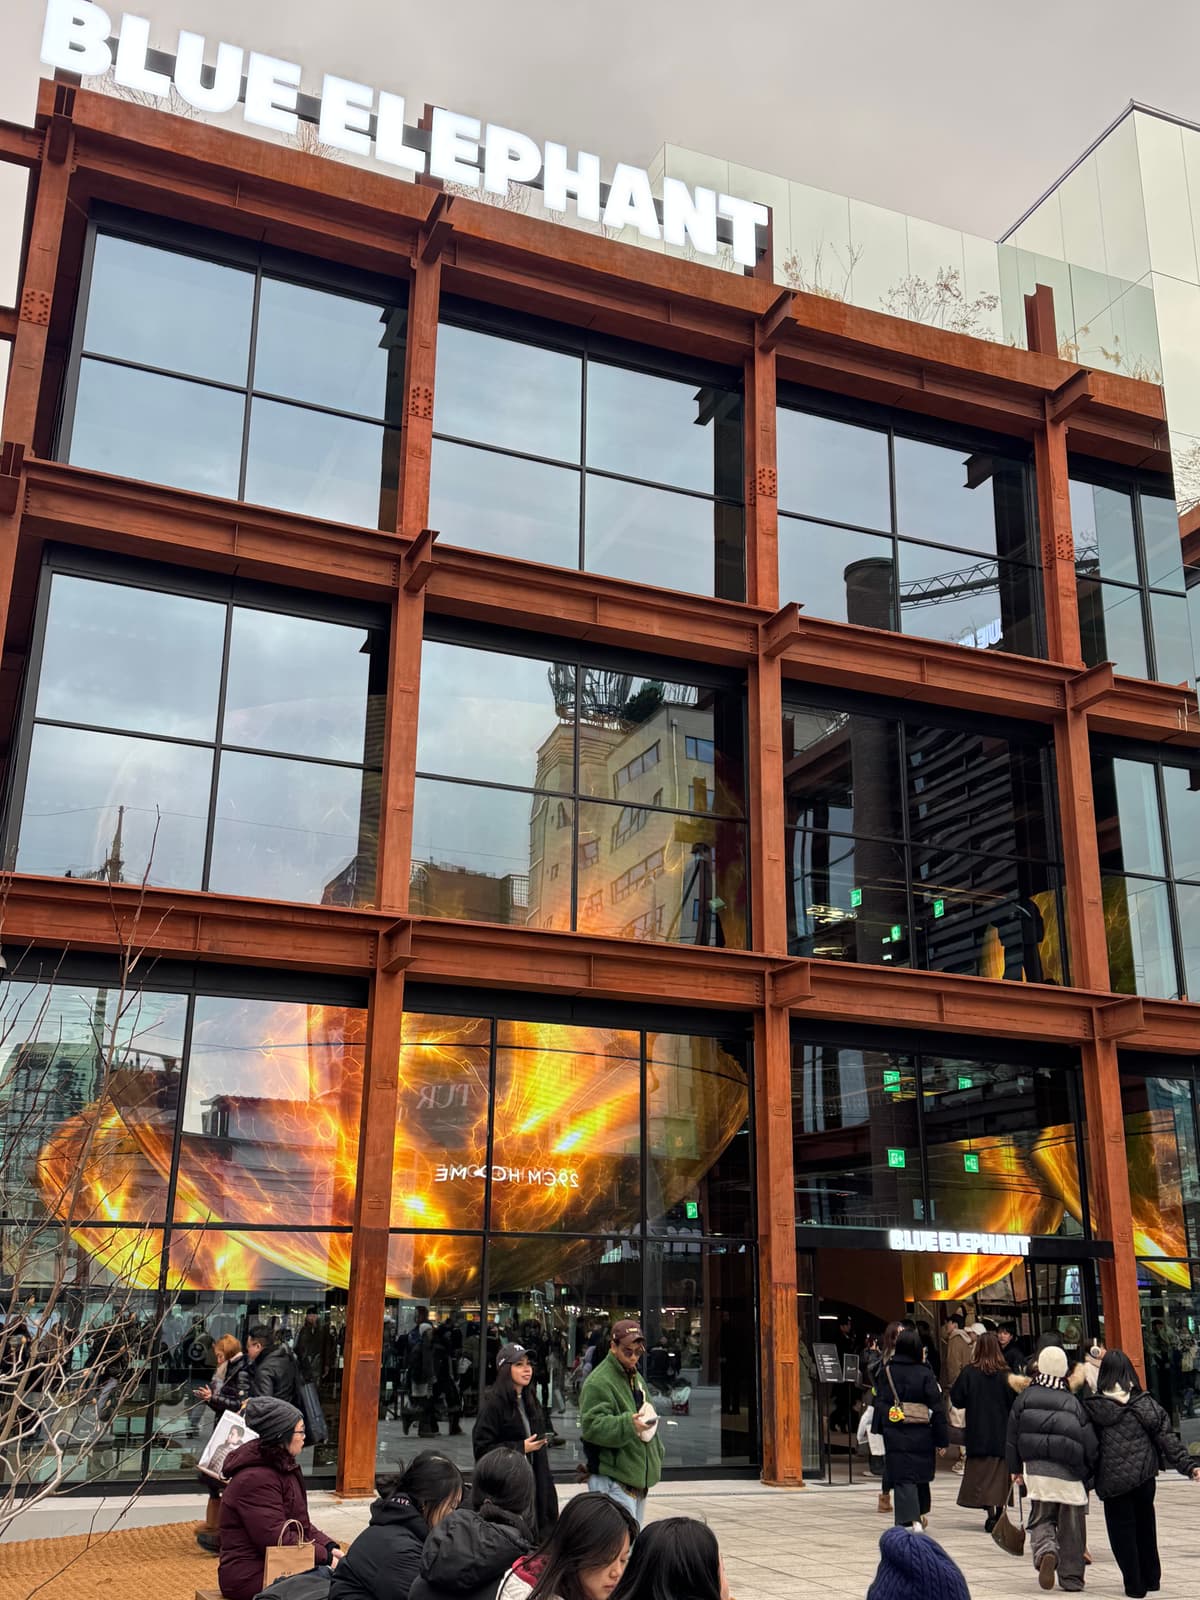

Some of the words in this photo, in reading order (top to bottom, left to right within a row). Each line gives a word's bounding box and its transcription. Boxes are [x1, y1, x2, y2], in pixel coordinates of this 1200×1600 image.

[40, 0, 301, 135] BLUE
[318, 73, 768, 267] ELEPHANT
[889, 1229, 938, 1252] BLUE
[938, 1231, 1031, 1256] ELEPHANT
